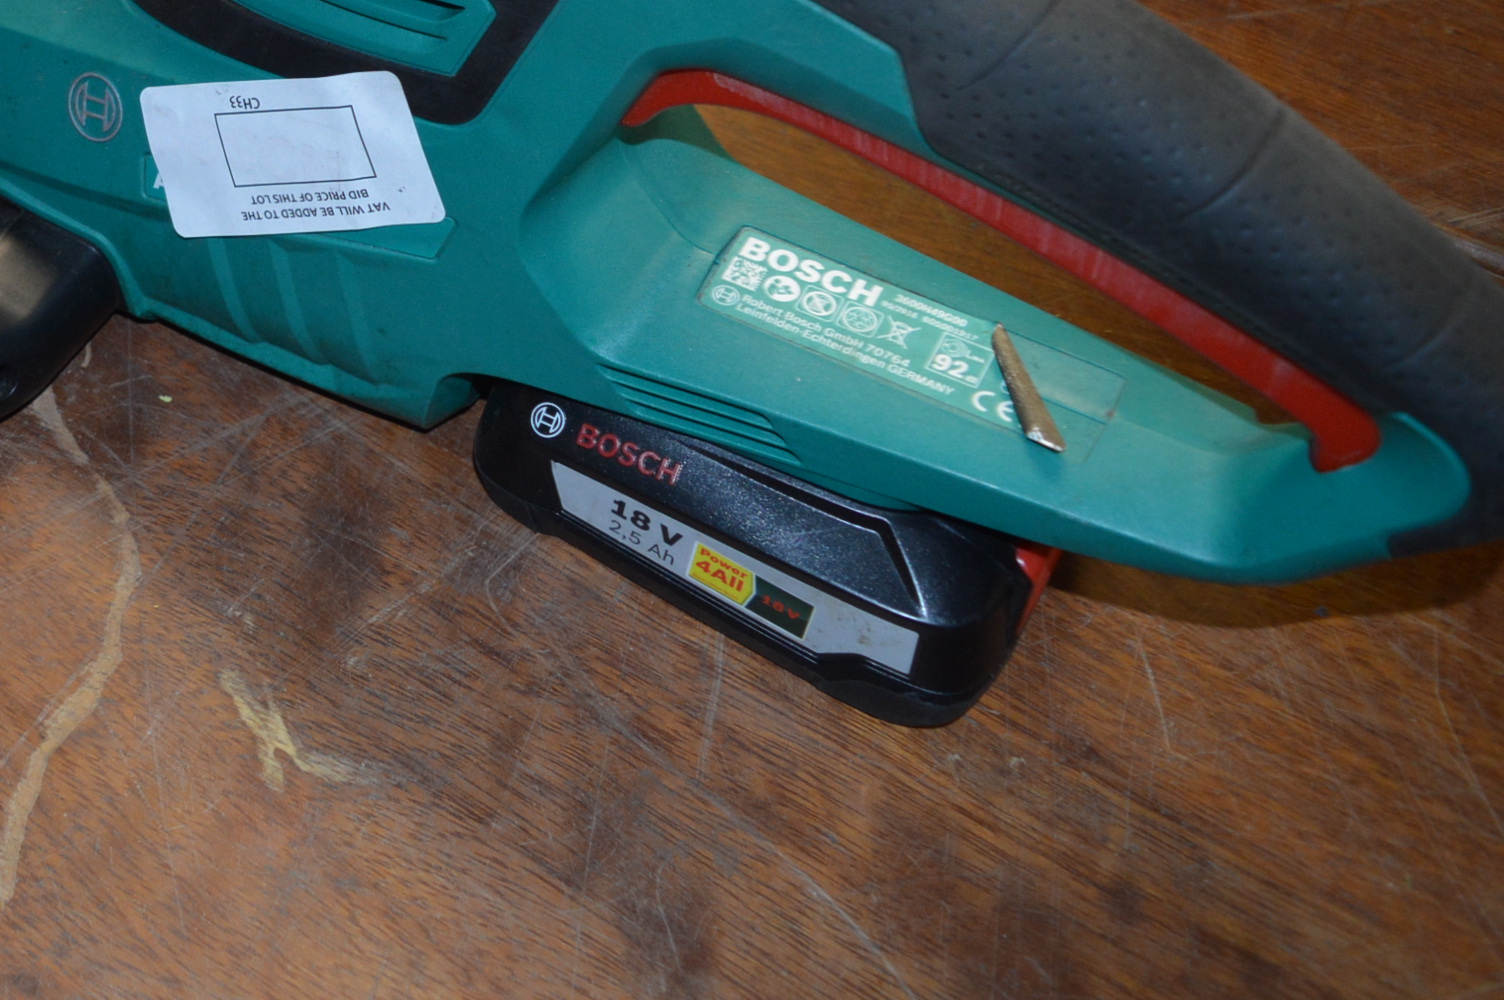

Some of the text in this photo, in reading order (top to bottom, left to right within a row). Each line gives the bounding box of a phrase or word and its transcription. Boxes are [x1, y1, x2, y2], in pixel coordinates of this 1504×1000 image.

[229, 95, 261, 109] CH33
[241, 201, 391, 221] VAT WILL BE ADDED TO THE
[251, 188, 369, 205] BID PRICE OF THIS LOT
[739, 236, 883, 307] BOSCH
[742, 294, 911, 367] Robert Bosch GmbH 70764
[886, 364, 956, 396] GERMANY
[931, 354, 969, 378] 92
[576, 423, 684, 486] BOSCH
[611, 499, 684, 547] 18 V
[608, 519, 676, 566] 2,5 Ah
[696, 561, 745, 592] 4All
[700, 547, 748, 579] Power
